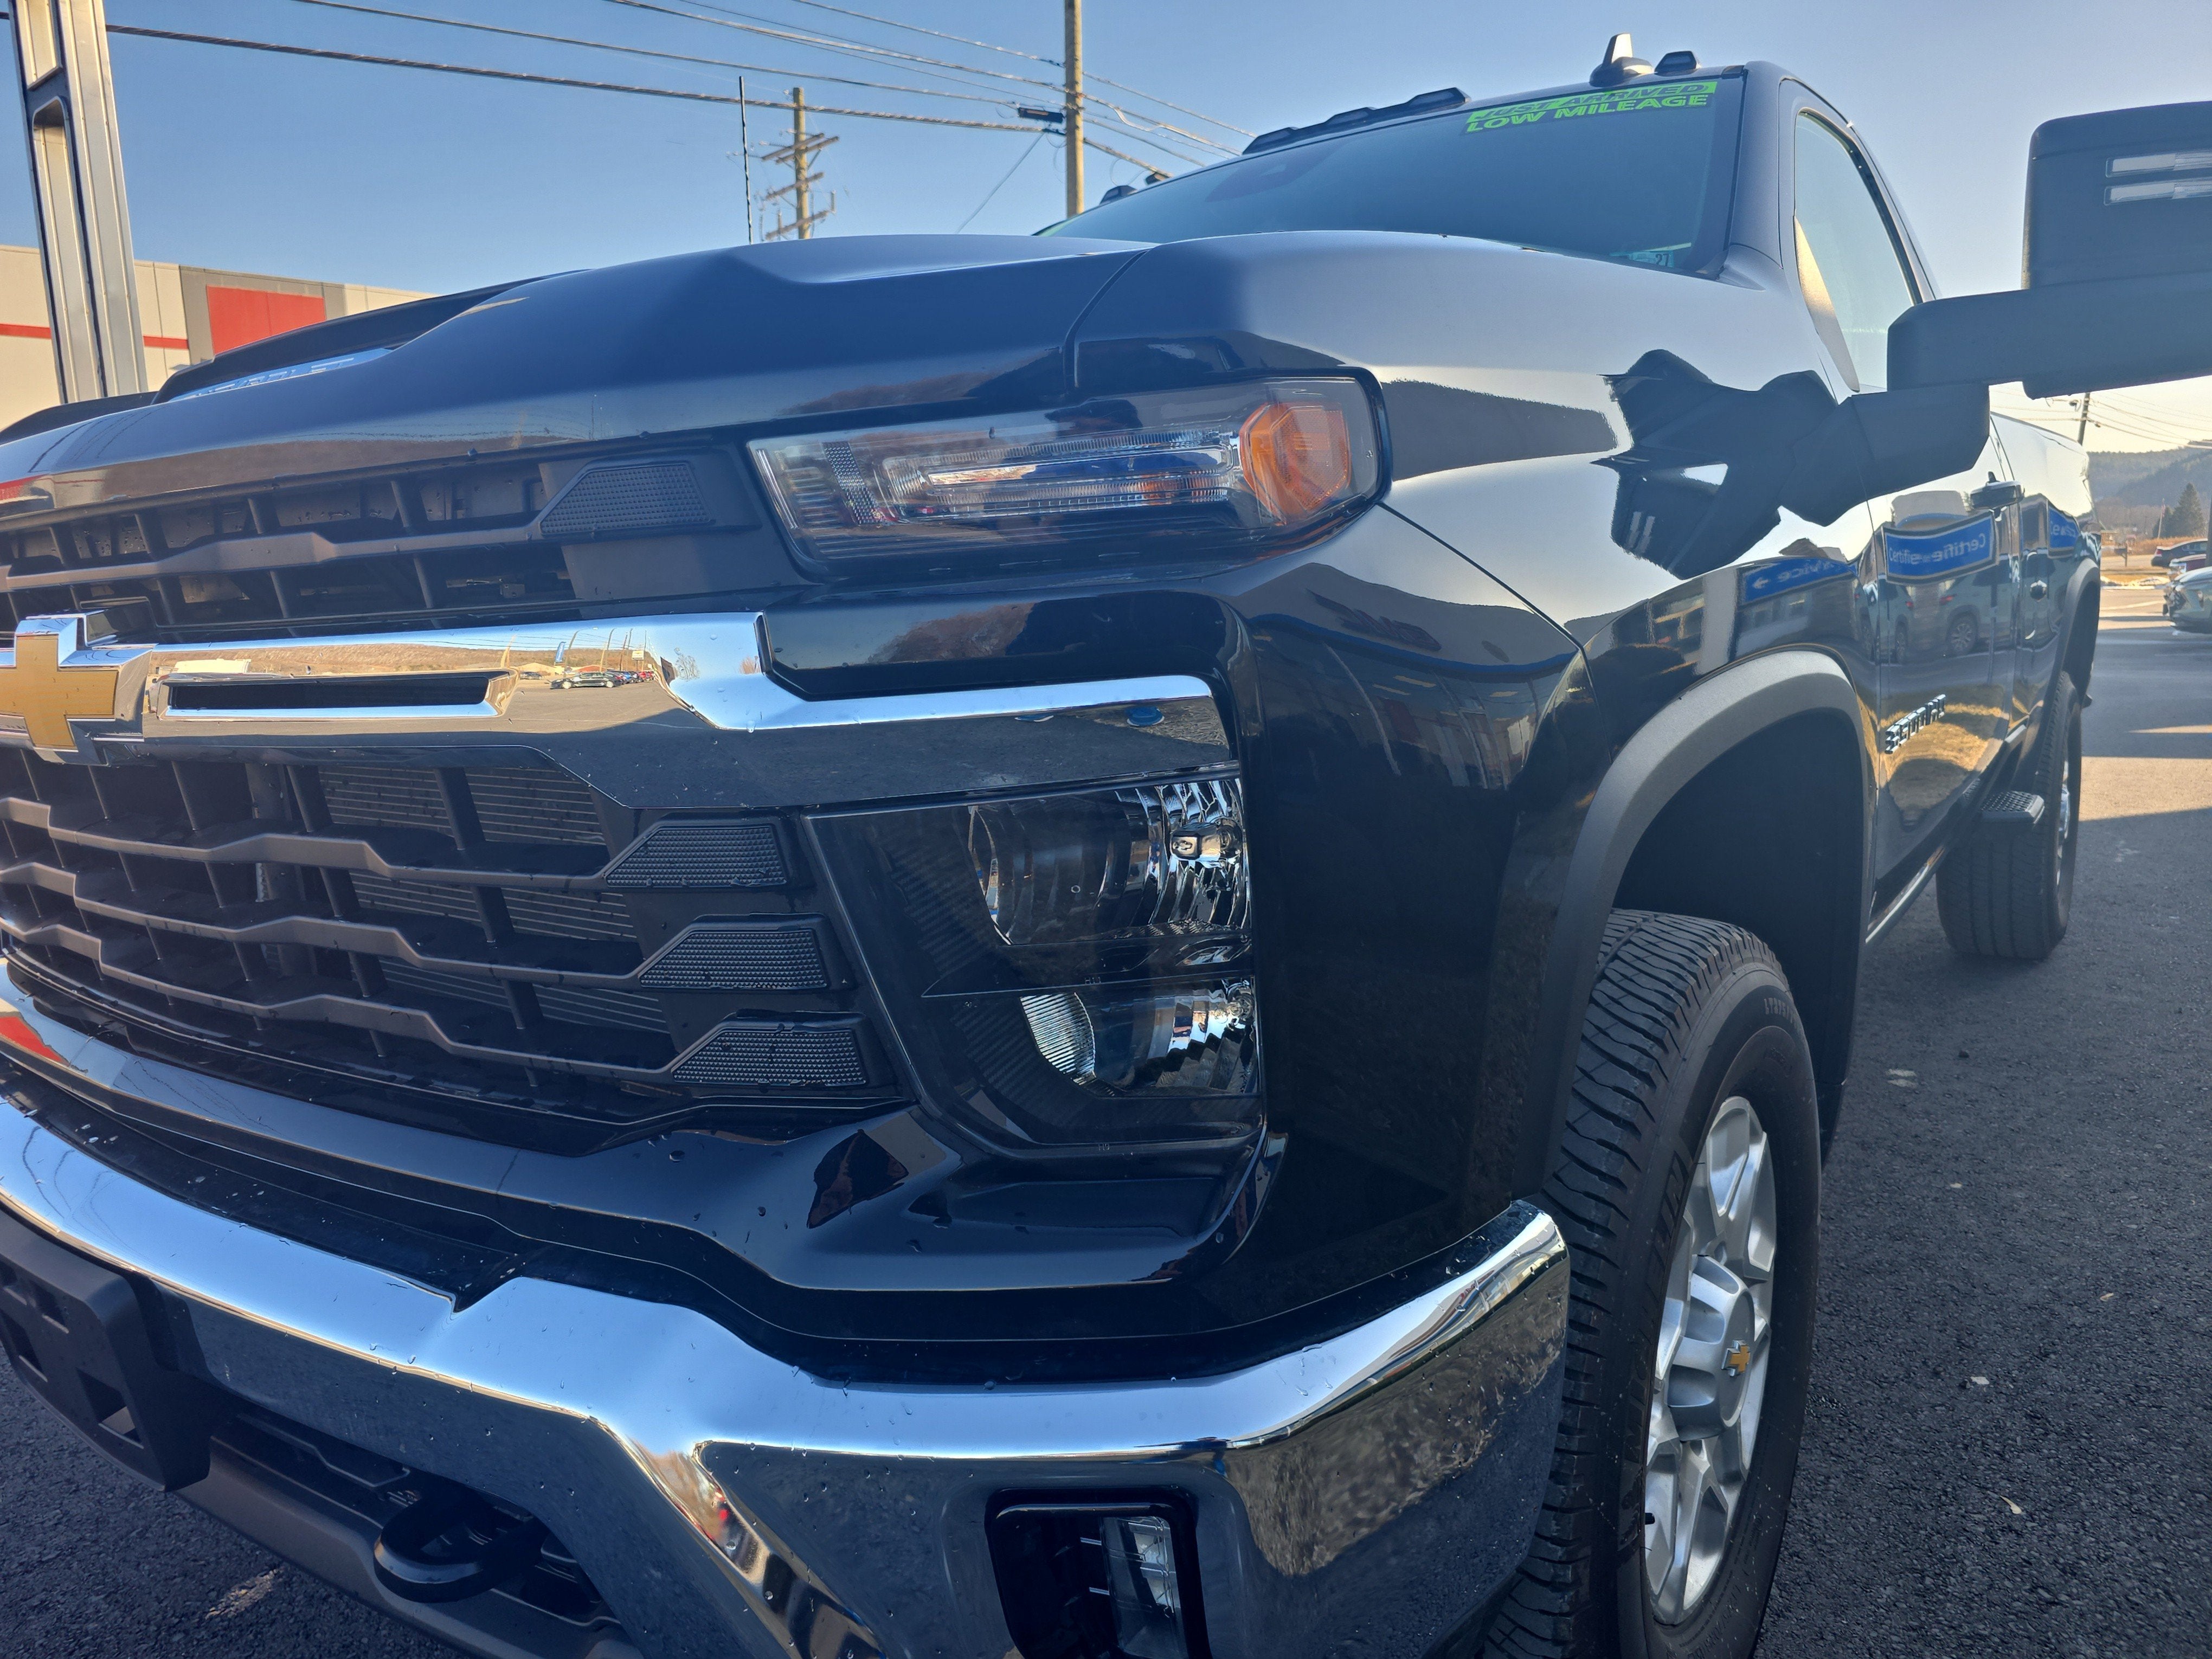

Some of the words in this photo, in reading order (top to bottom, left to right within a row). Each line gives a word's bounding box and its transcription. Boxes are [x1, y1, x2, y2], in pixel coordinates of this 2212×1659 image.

[1466, 111, 1545, 132] LOW
[1554, 94, 1708, 119] MILEAGE
[1476, 102, 1556, 119] JUST
[1559, 84, 1709, 106] ARRIVED
